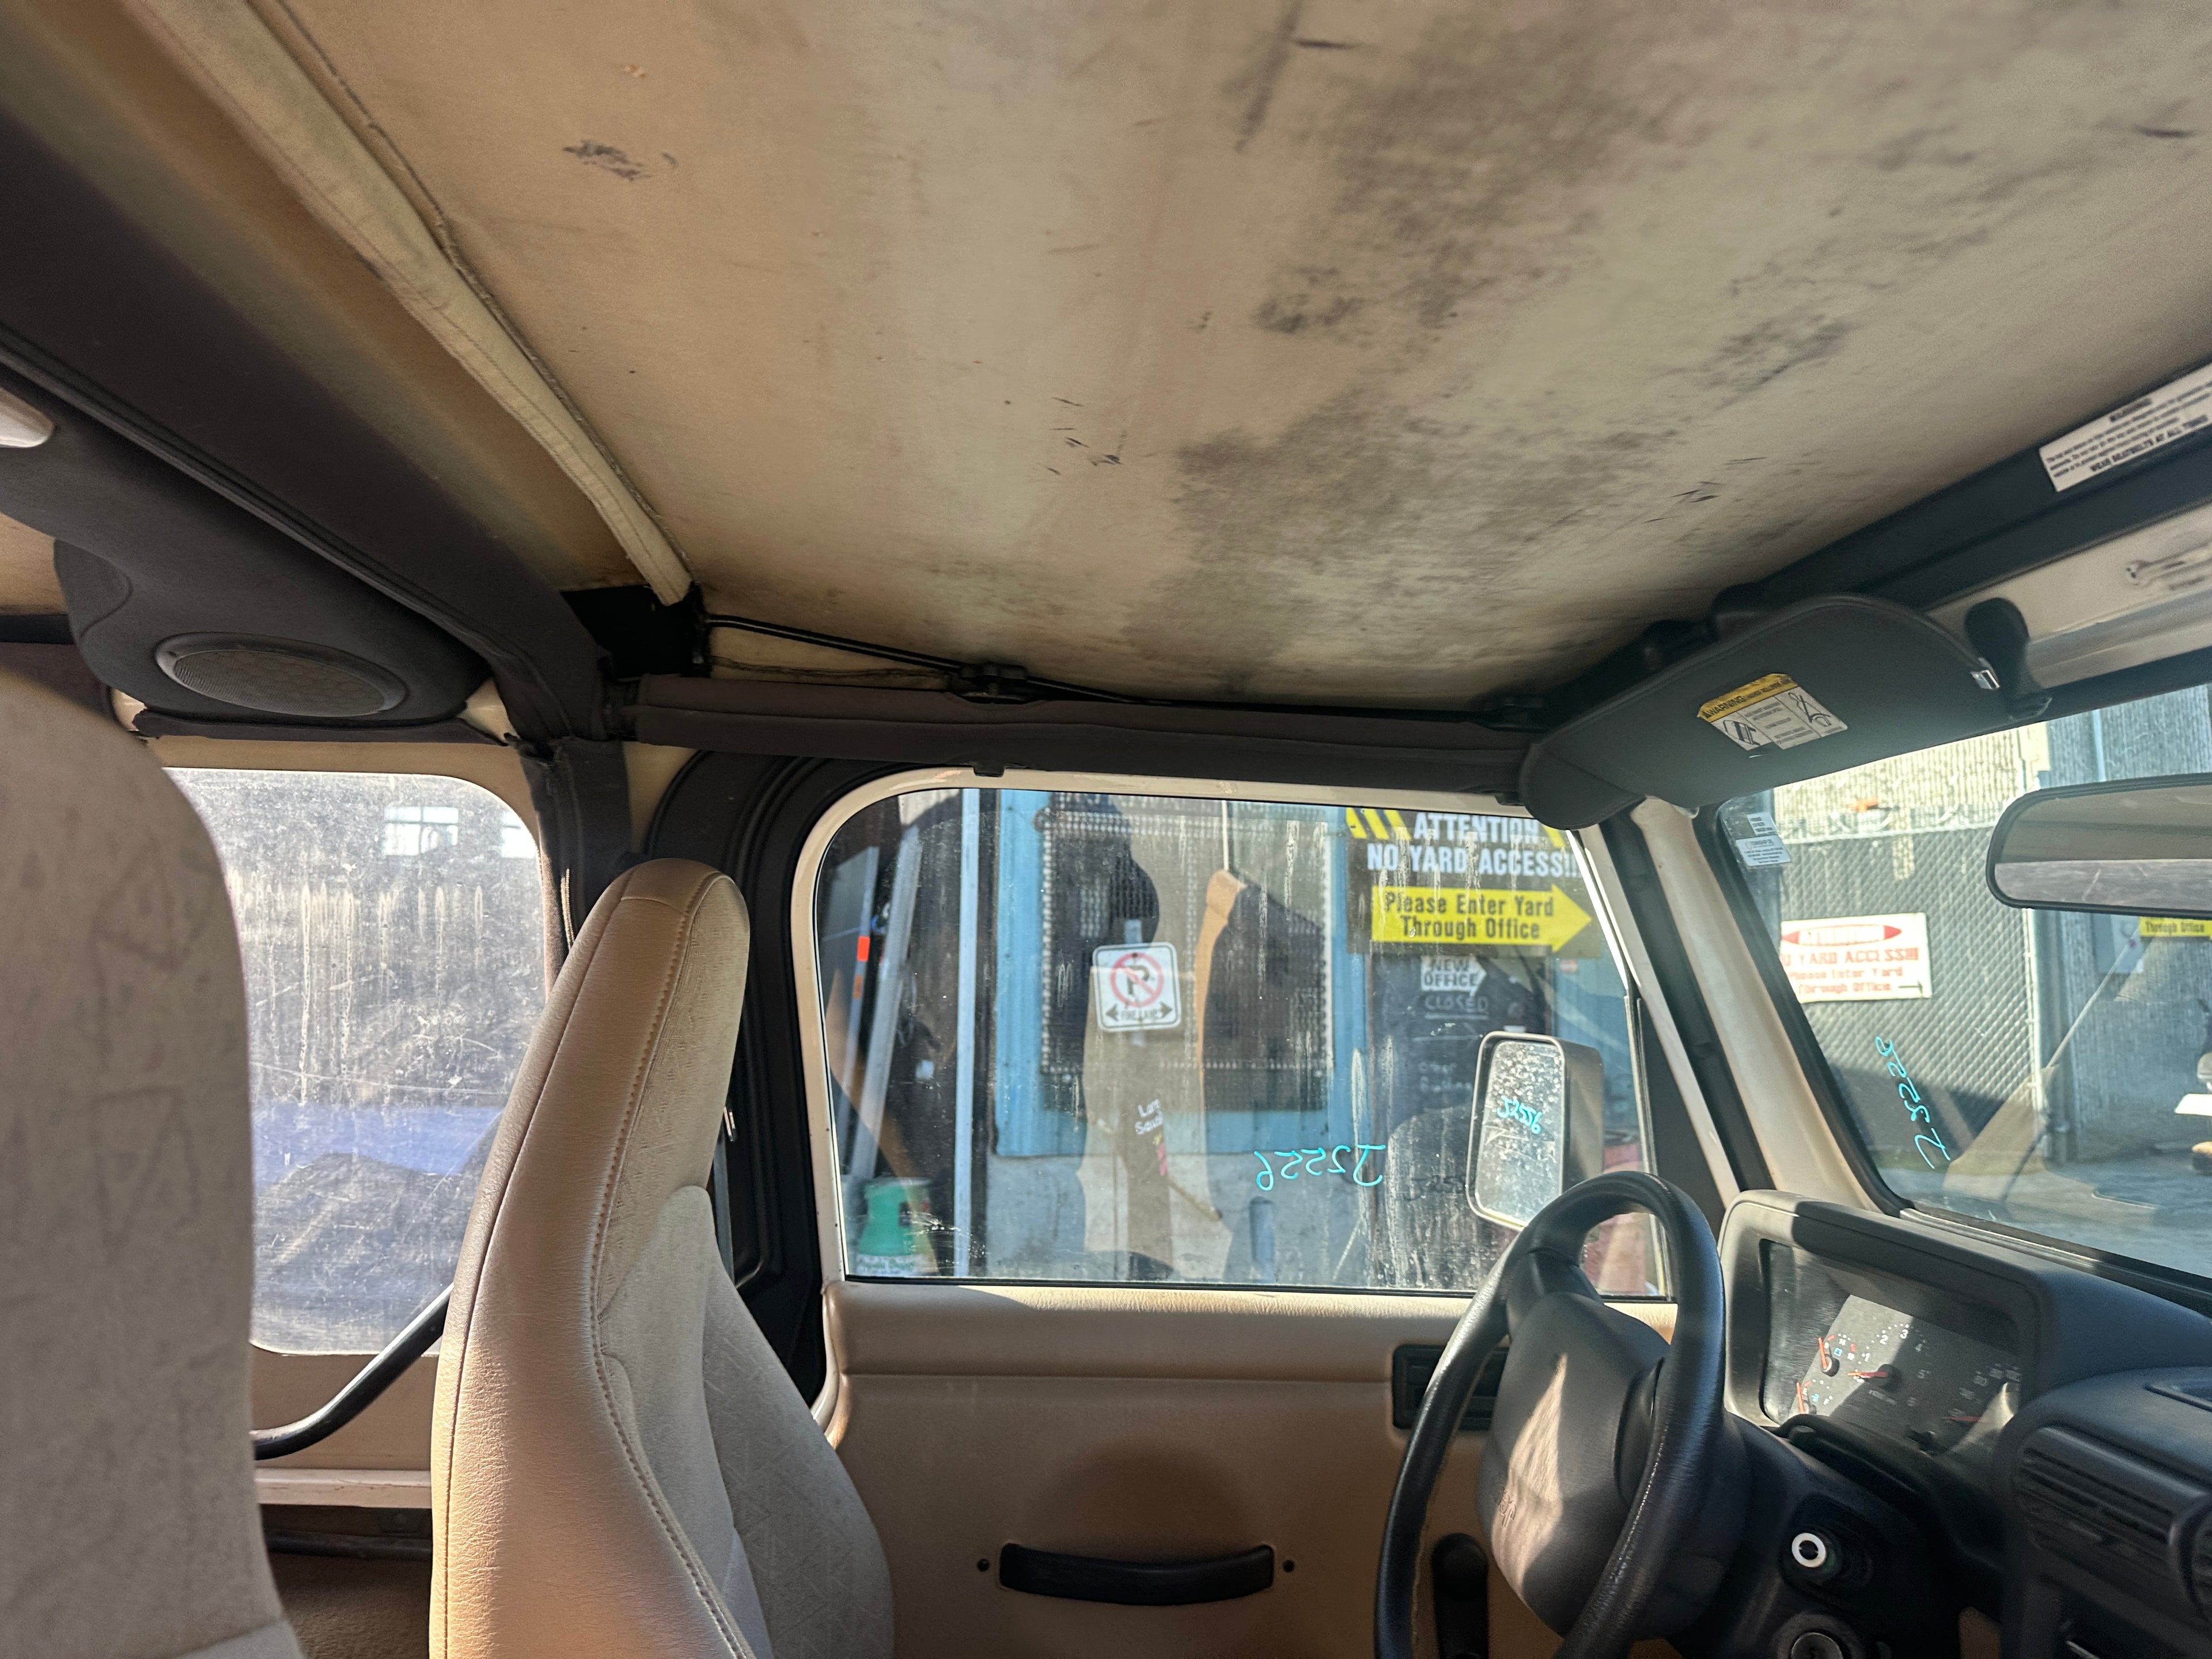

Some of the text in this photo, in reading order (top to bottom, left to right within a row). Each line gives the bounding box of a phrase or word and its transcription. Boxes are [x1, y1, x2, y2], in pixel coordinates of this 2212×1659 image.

[1709, 696, 1747, 717] WARNING
[1413, 812, 1540, 844] ATTENTION
[1367, 842, 1399, 872] NO
[1410, 844, 1468, 874] YARD
[1384, 891, 1554, 917] Please Enter Yard
[1400, 915, 1540, 941] Through Office
[1800, 952, 1838, 964] YARD
[1424, 972, 1479, 987] OFFICE
[1496, 1095, 1543, 1135] J2556
[1879, 1334, 1889, 1345] 2
[1900, 1328, 1909, 1339] 3
[1864, 1352, 1870, 1362] 1
[1914, 1343, 1923, 1353] 4
